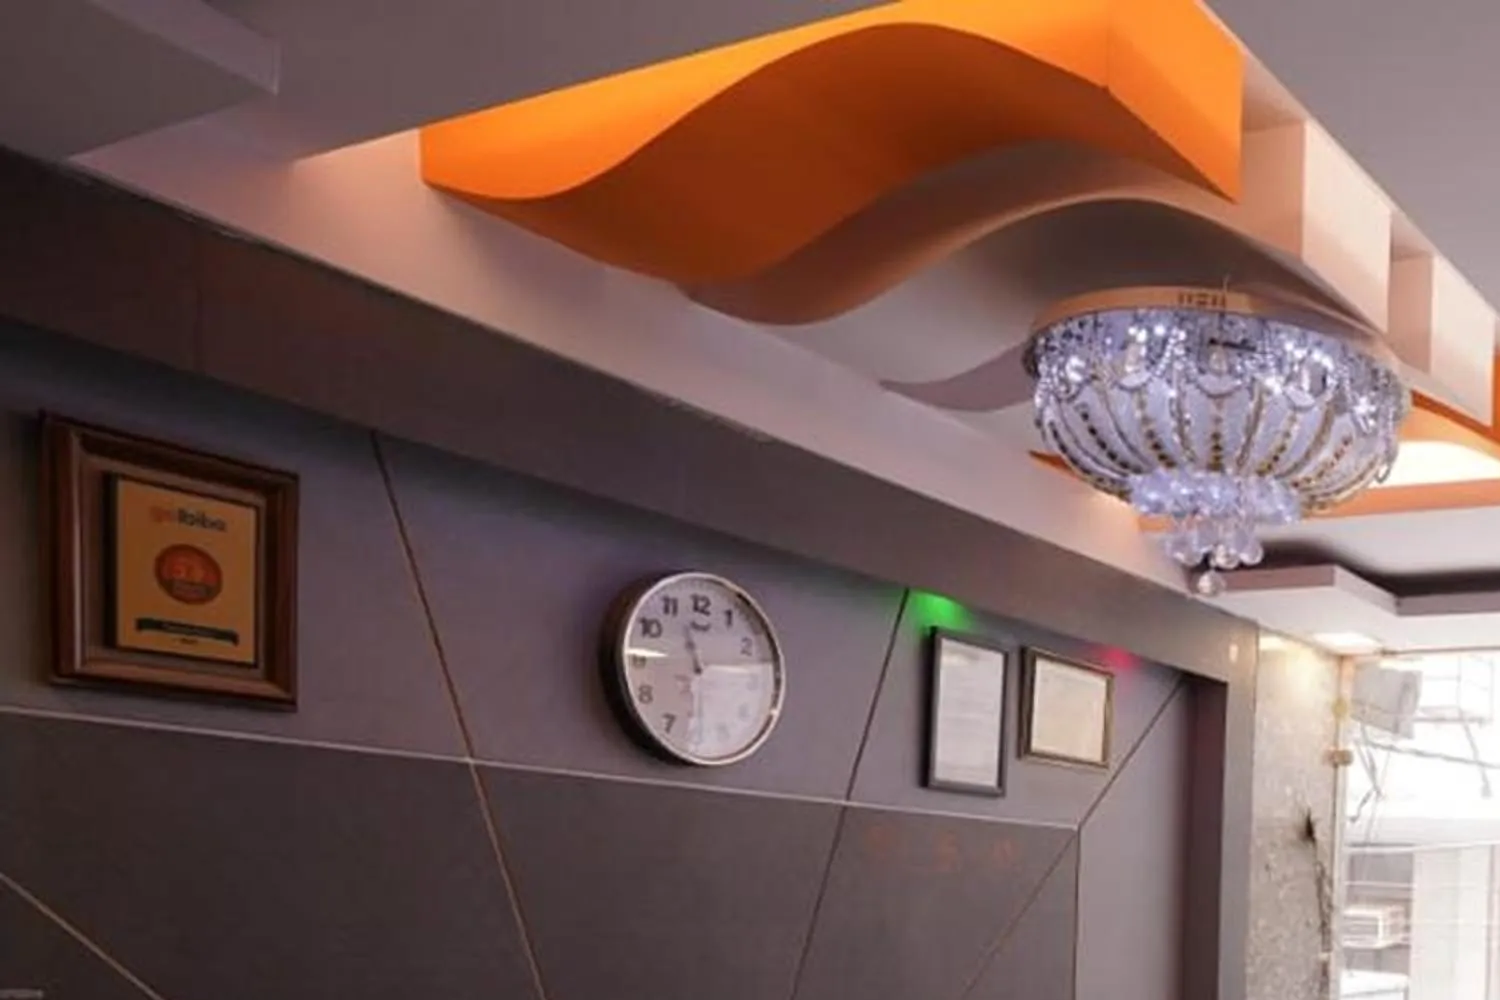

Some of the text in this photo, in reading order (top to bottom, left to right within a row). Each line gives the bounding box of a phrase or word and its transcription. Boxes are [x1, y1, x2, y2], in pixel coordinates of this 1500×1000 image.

[662, 595, 679, 617] 11
[690, 592, 711, 616] 12
[639, 616, 663, 639] 10
[724, 608, 733, 629] 1
[740, 636, 753, 656] 2
[638, 684, 654, 704] 8
[662, 713, 676, 734] 7
